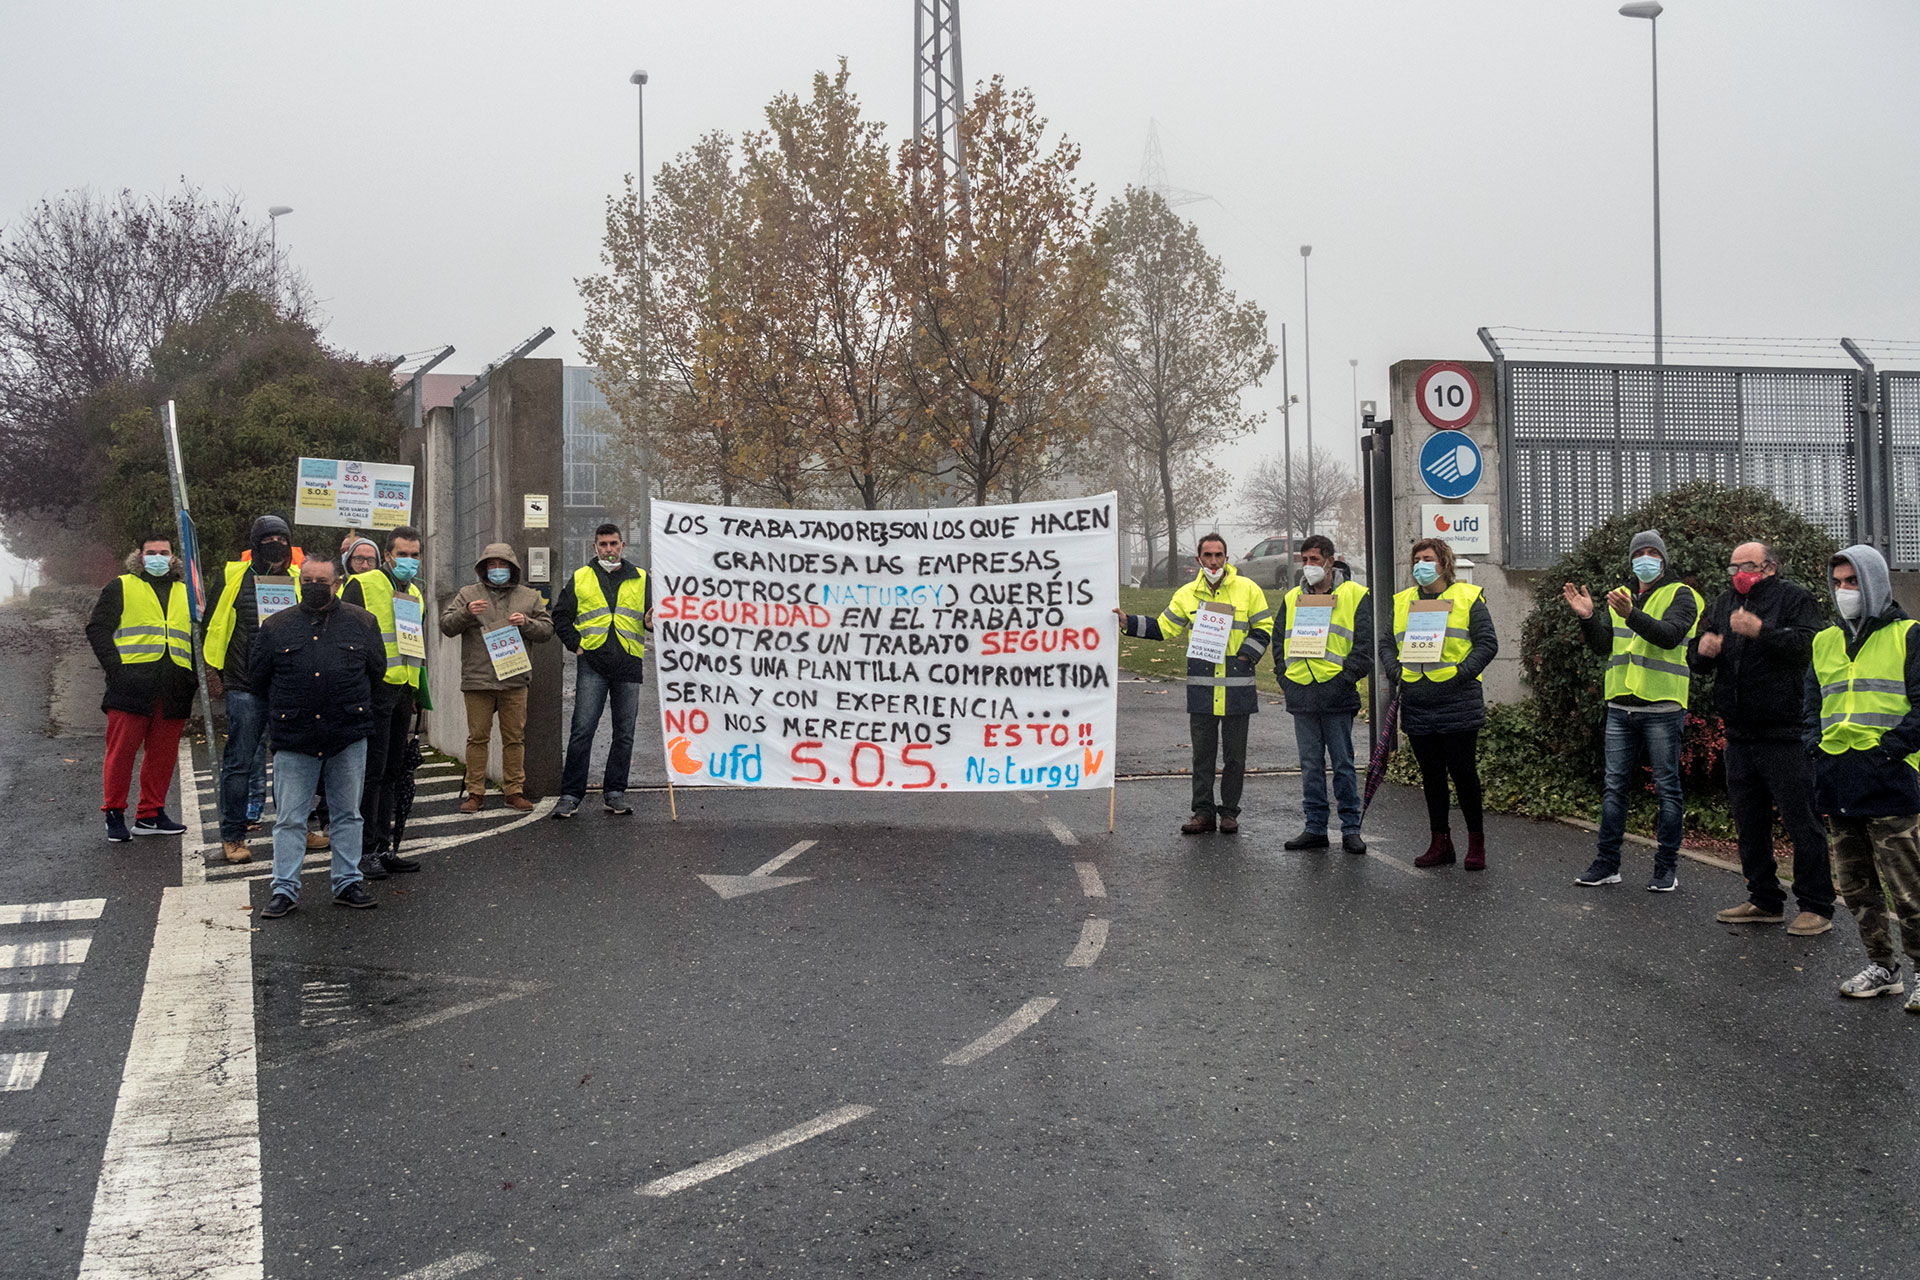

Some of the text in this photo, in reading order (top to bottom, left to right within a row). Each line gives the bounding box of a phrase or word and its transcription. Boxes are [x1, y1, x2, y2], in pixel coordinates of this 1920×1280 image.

[1434, 385, 1464, 407] 10
[344, 474, 369, 482] S.O.S.
[378, 490, 406, 500] S.O.S.
[664, 514, 708, 535] LOS
[889, 522, 928, 540] SON
[933, 520, 965, 540] LOS
[970, 516, 1019, 538] QUE
[1031, 505, 1110, 534] HACEN
[1454, 516, 1478, 532] ufd
[714, 550, 1060, 576] GRANDES A LAS EMPRESAS
[262, 596, 293, 605] S.O.S.
[970, 571, 1094, 606] QUERÉIS
[658, 596, 1064, 630] SEGURIDAD EN EL TRABAJO
[1202, 614, 1226, 625] S.O.S.
[662, 621, 1100, 655] NOSOTROS UN TRABAJO SEGURO
[1200, 623, 1220, 632] Naturgy
[491, 636, 518, 650] S.O.S.
[1204, 652, 1220, 660] CALLE
[660, 650, 1110, 688] SOMOS UNA PLANTILLA COMPROMETIDA
[666, 682, 739, 704] SERIA
[749, 686, 764, 706] Y
[772, 690, 818, 709] CON
[665, 708, 709, 734] NO
[724, 714, 766, 734] NOS
[783, 718, 950, 745] MERECEMOS
[710, 741, 1079, 788] ufd S.O.S. Naturgy
